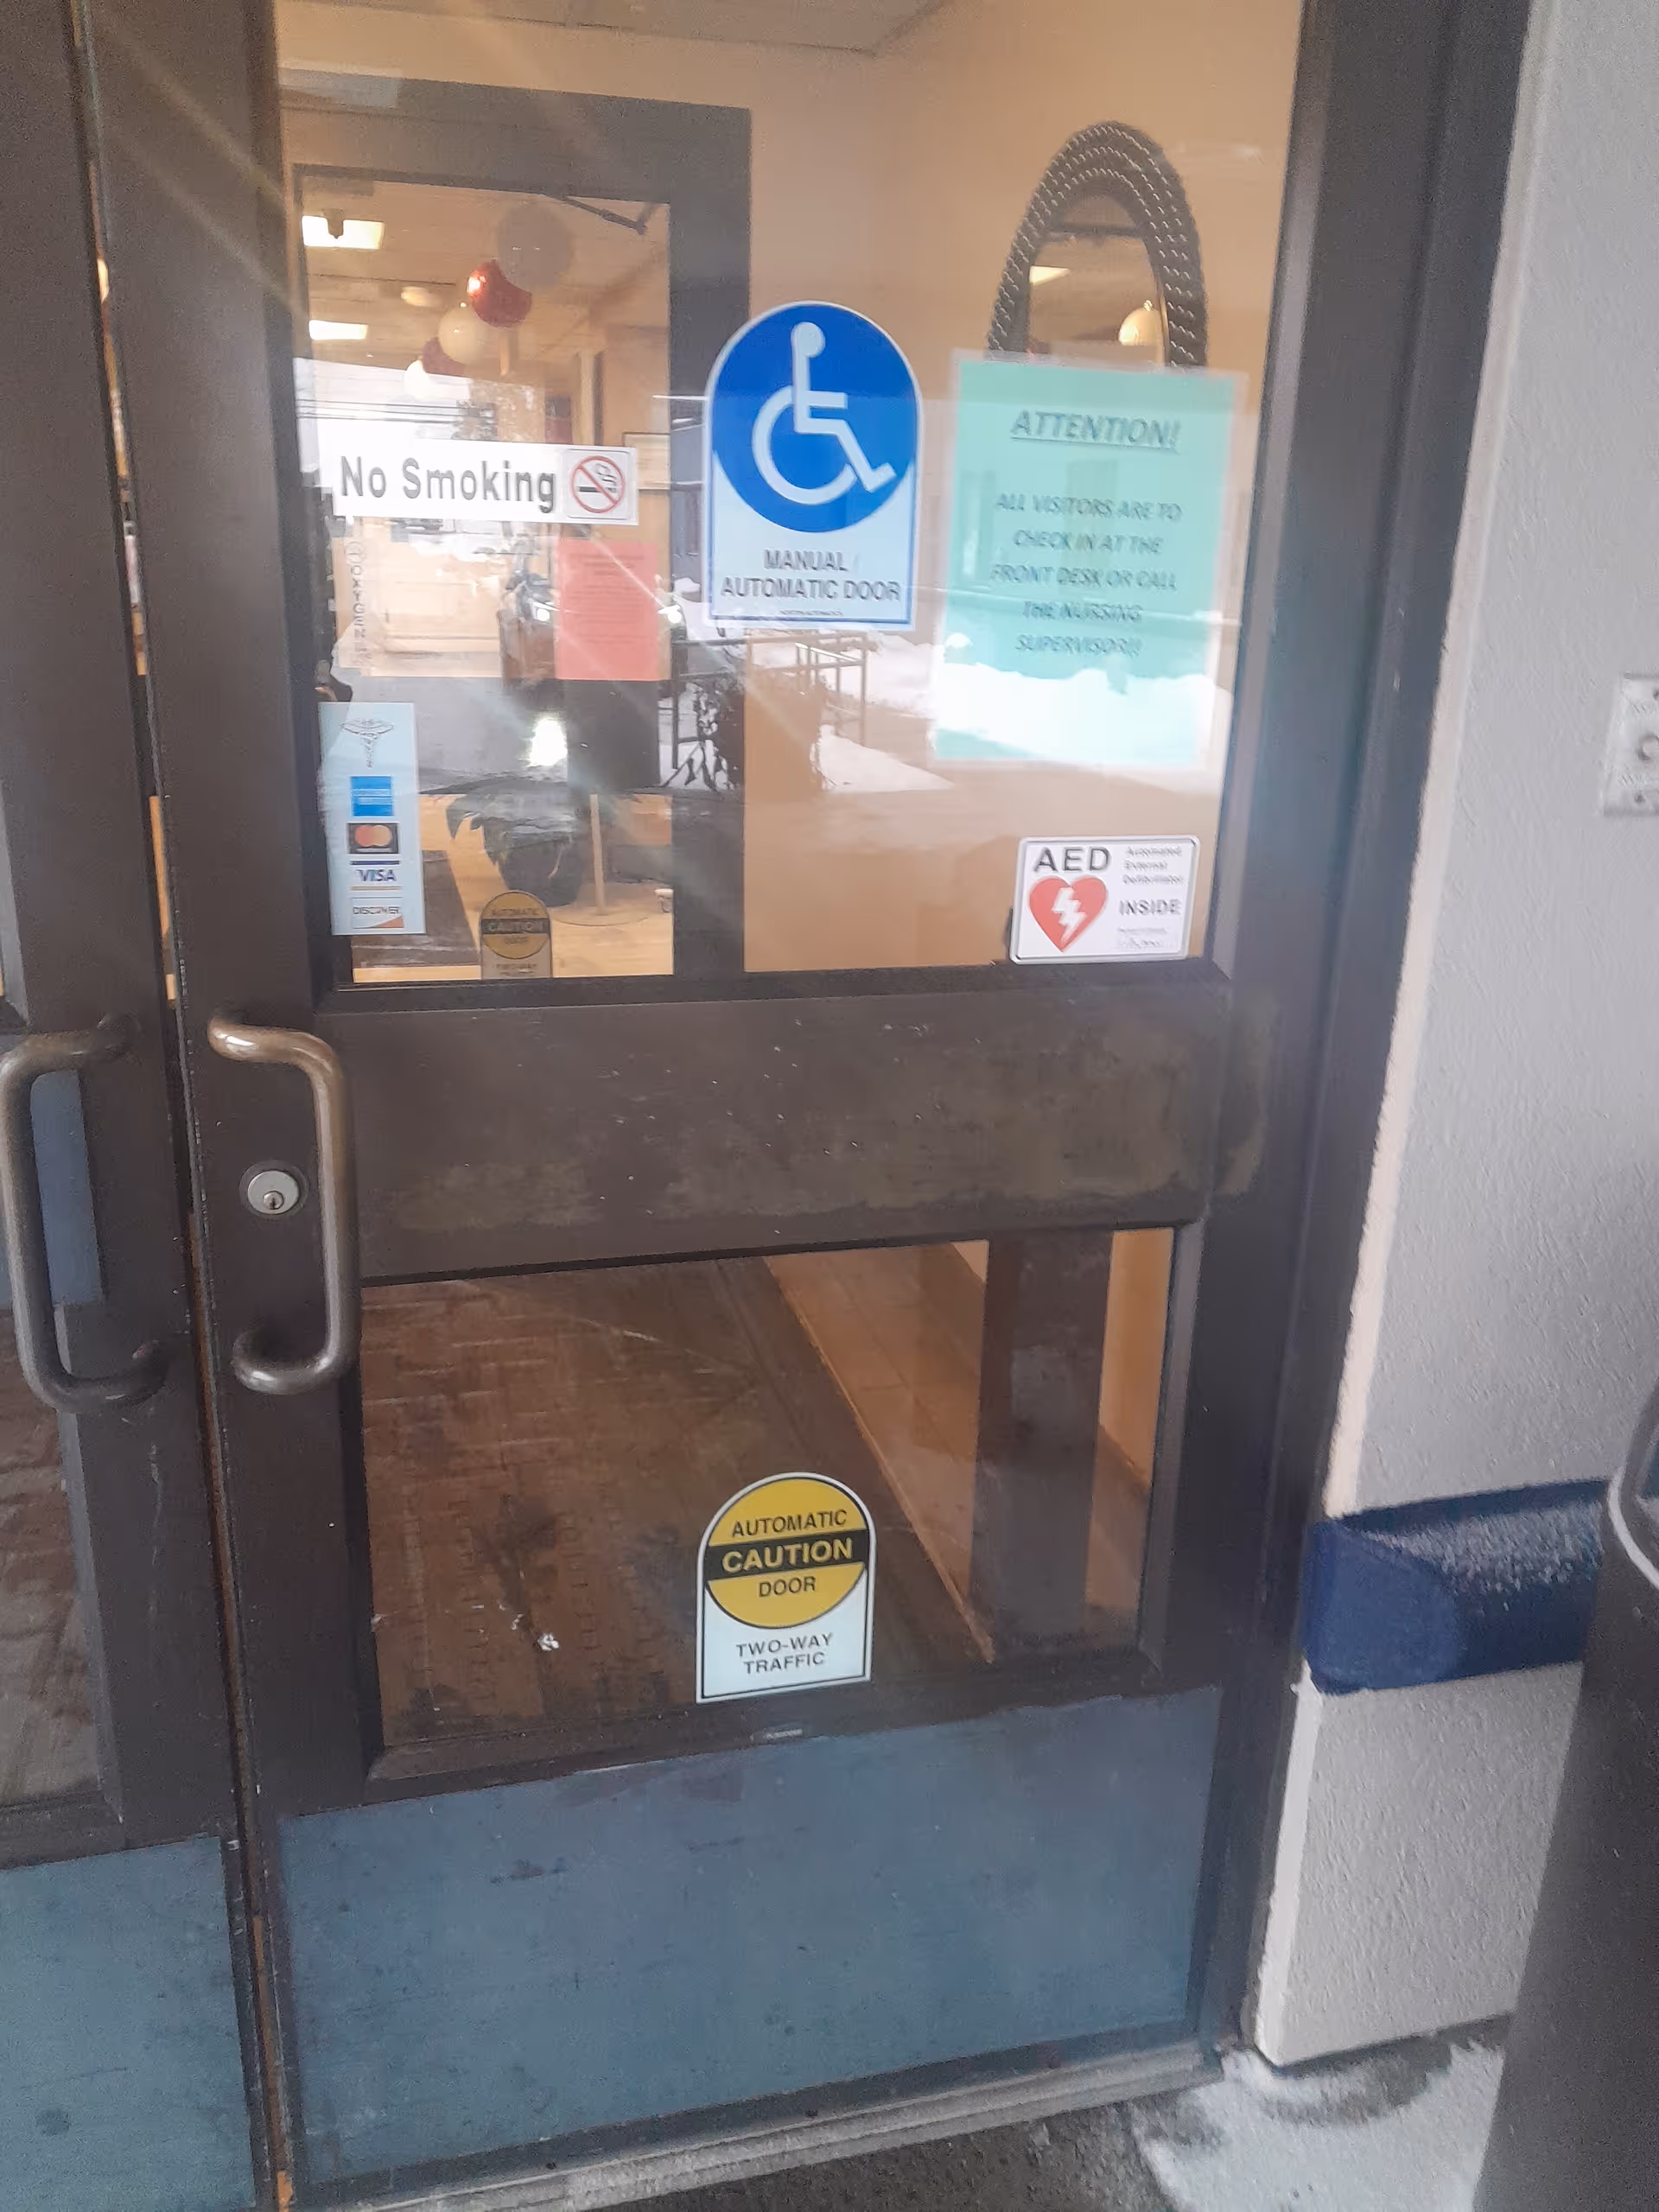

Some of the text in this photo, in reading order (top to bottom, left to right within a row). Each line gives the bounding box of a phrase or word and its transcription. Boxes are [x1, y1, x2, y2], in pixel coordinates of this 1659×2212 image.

[1010, 410, 1182, 449] ATTENTION!
[340, 456, 556, 513] No Smoking
[996, 493, 1183, 521] ALL VISITORS ARE TO
[1014, 530, 1071, 550] CHECK
[1097, 534, 1126, 552] AT
[764, 549, 849, 571] MANUAL
[721, 576, 901, 602] AUTOMATIC DOOR
[1033, 846, 1112, 873] AED
[357, 869, 397, 882] VISA
[1120, 899, 1182, 916] INSIDE
[732, 1509, 848, 1537] AUTOMATIC
[721, 1537, 854, 1573] CAUTION
[759, 1575, 817, 1598] DOOR
[735, 1631, 834, 1658] TWO-WAY
[743, 1651, 826, 1675] TRAFFIC
